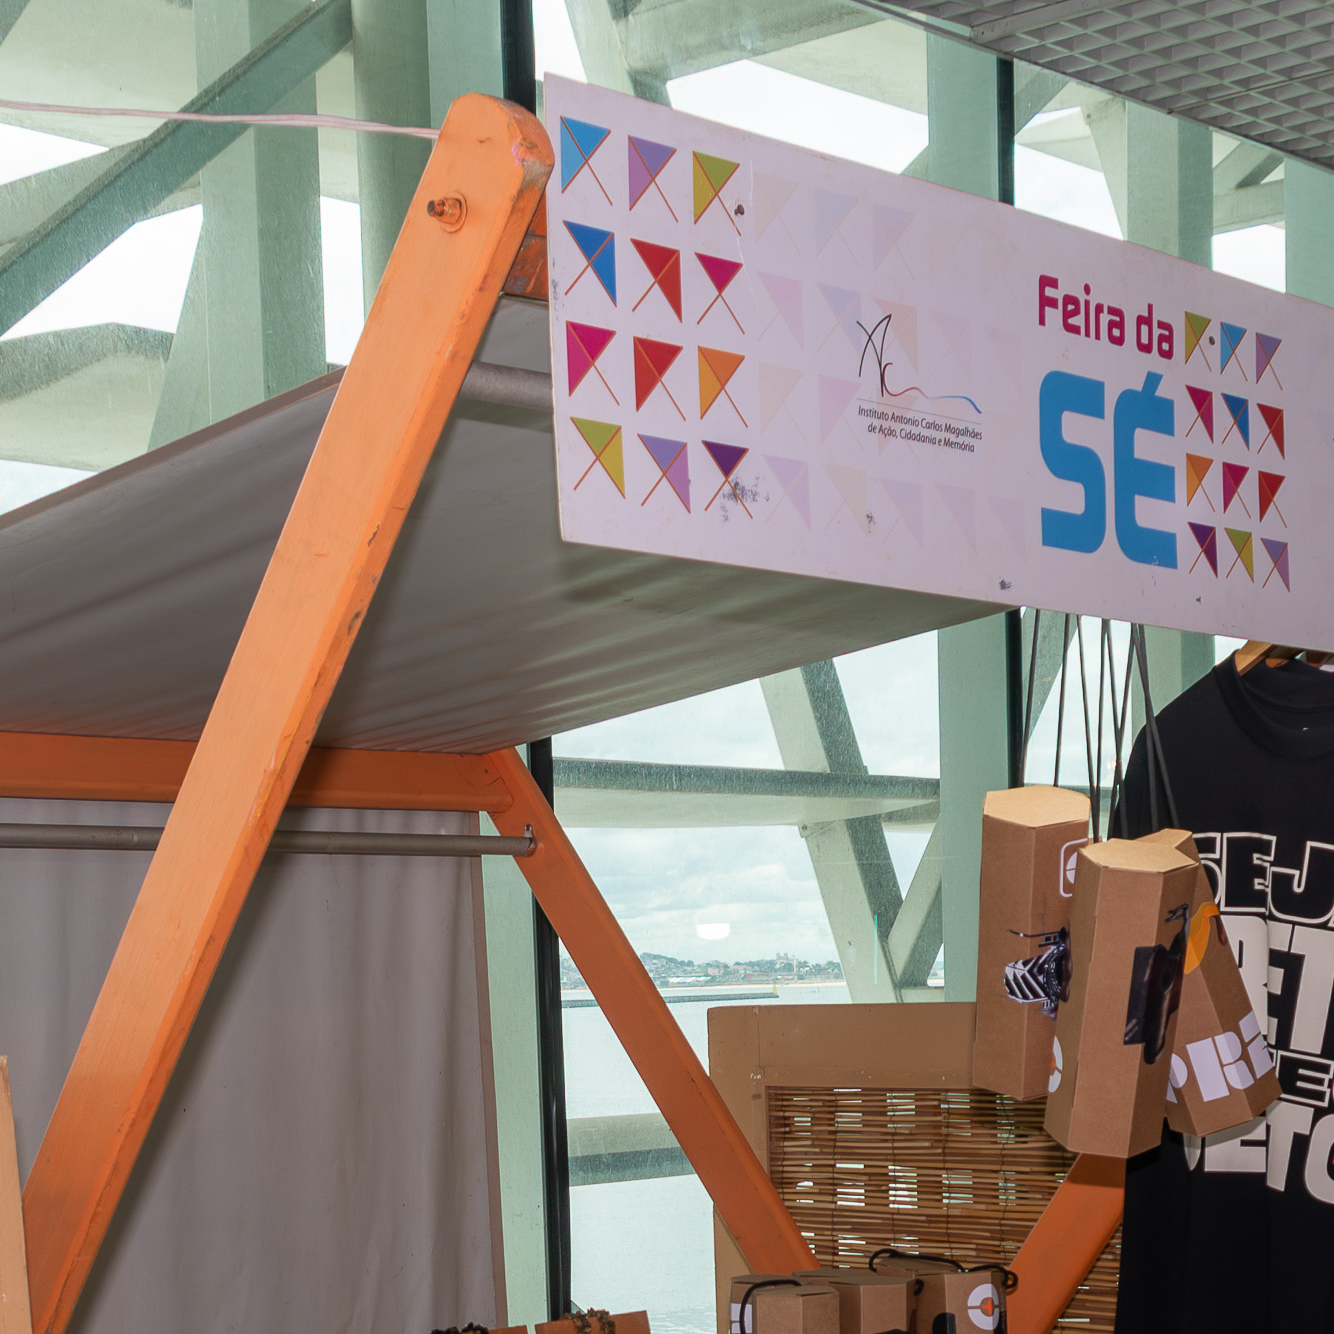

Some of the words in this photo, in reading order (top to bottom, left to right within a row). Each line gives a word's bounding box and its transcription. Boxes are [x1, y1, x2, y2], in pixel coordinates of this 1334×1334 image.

[1038, 274, 1125, 347] Feira
[1136, 303, 1174, 360] da
[858, 405, 890, 422] Instituto
[890, 412, 920, 427] Antonio
[920, 418, 943, 433] Carlos
[944, 422, 983, 441] Magalhães
[867, 422, 877, 434] de
[878, 424, 898, 440] Ação,
[899, 428, 937, 446] Cidadania
[943, 437, 975, 453] Memória
[1039, 370, 1178, 570] SÉ
